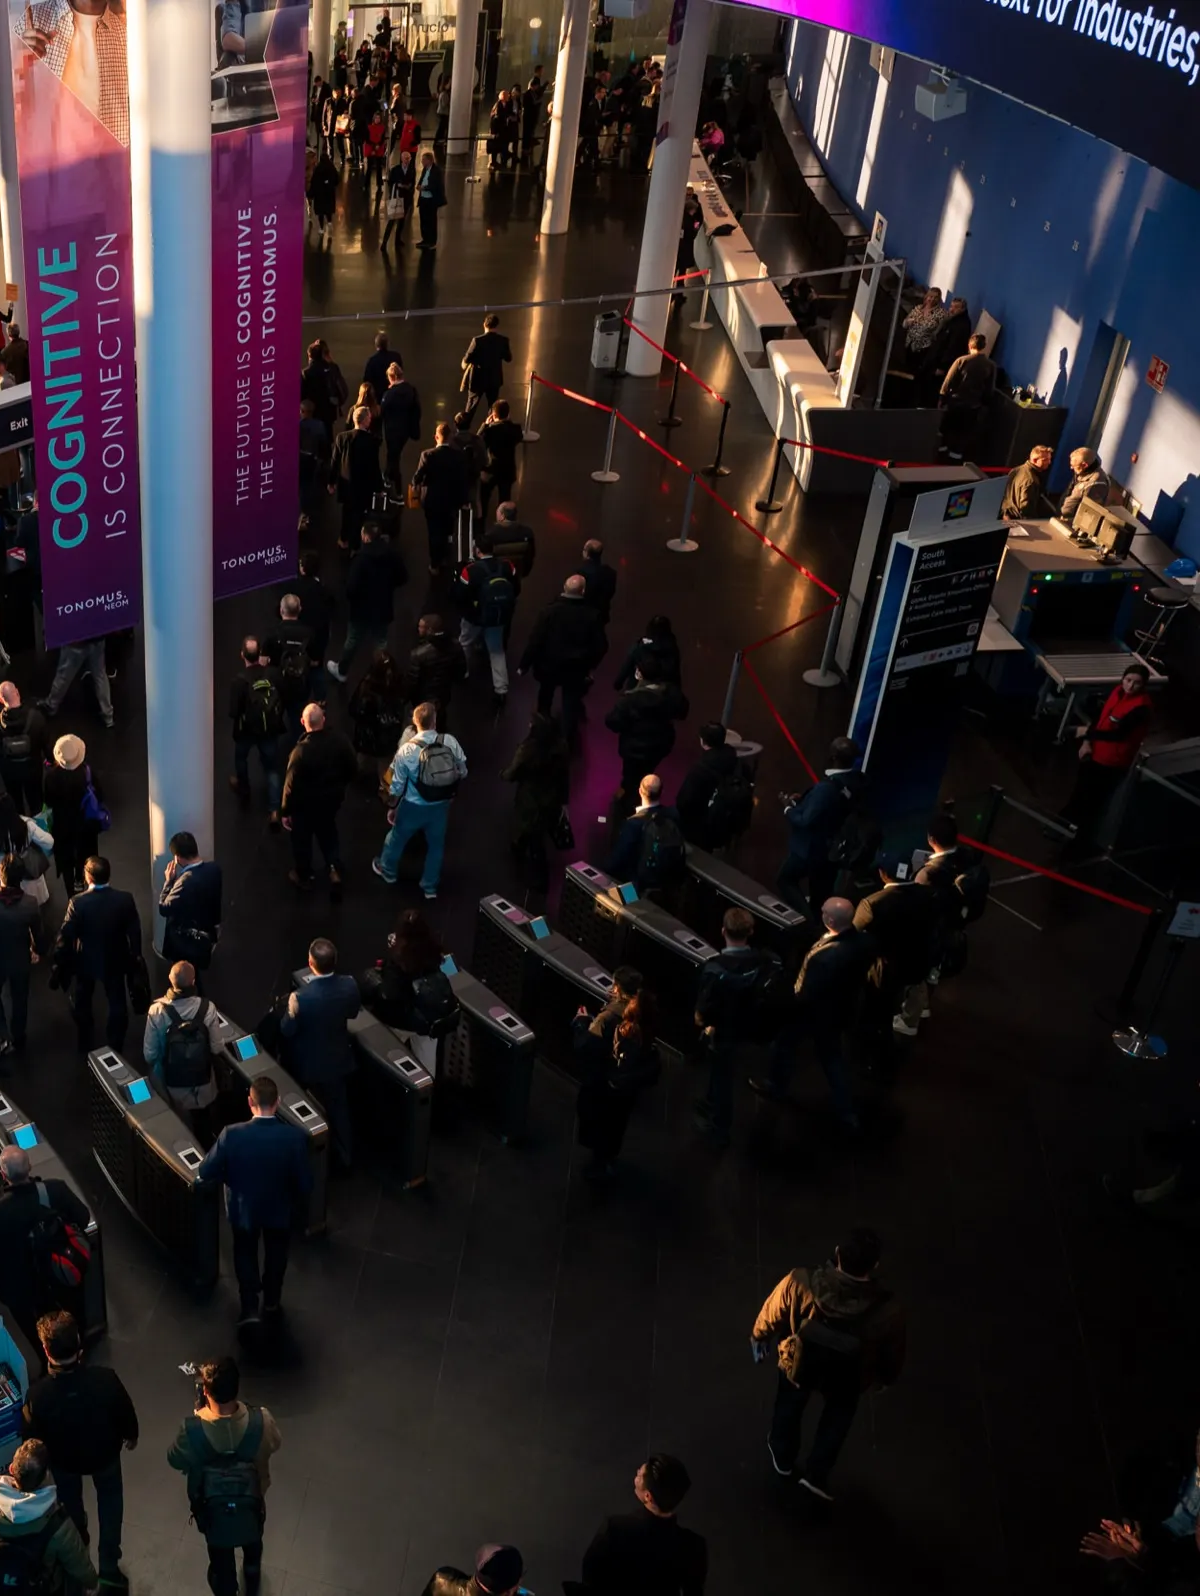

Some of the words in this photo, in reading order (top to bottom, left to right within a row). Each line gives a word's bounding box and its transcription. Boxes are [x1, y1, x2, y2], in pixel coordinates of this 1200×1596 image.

[237, 200, 251, 344] COGNITIVE.
[262, 205, 277, 339] TONOMUS.
[94, 232, 126, 494] CONNECTION
[237, 351, 250, 370] IS
[262, 344, 275, 364] IS
[36, 241, 89, 549] COGNITIVE
[10, 417, 29, 431] Exit
[237, 376, 250, 459] FUTURE
[261, 370, 275, 452] FUTURE
[236, 464, 249, 505] THE
[260, 458, 273, 499] THE
[104, 509, 127, 538] IS
[222, 544, 286, 570] TONOMUS.
[264, 553, 287, 566] NEOM
[919, 559, 946, 570] Access
[921, 549, 945, 561] South
[56, 590, 127, 615] TONOMUS.
[104, 598, 129, 611] NEOM
